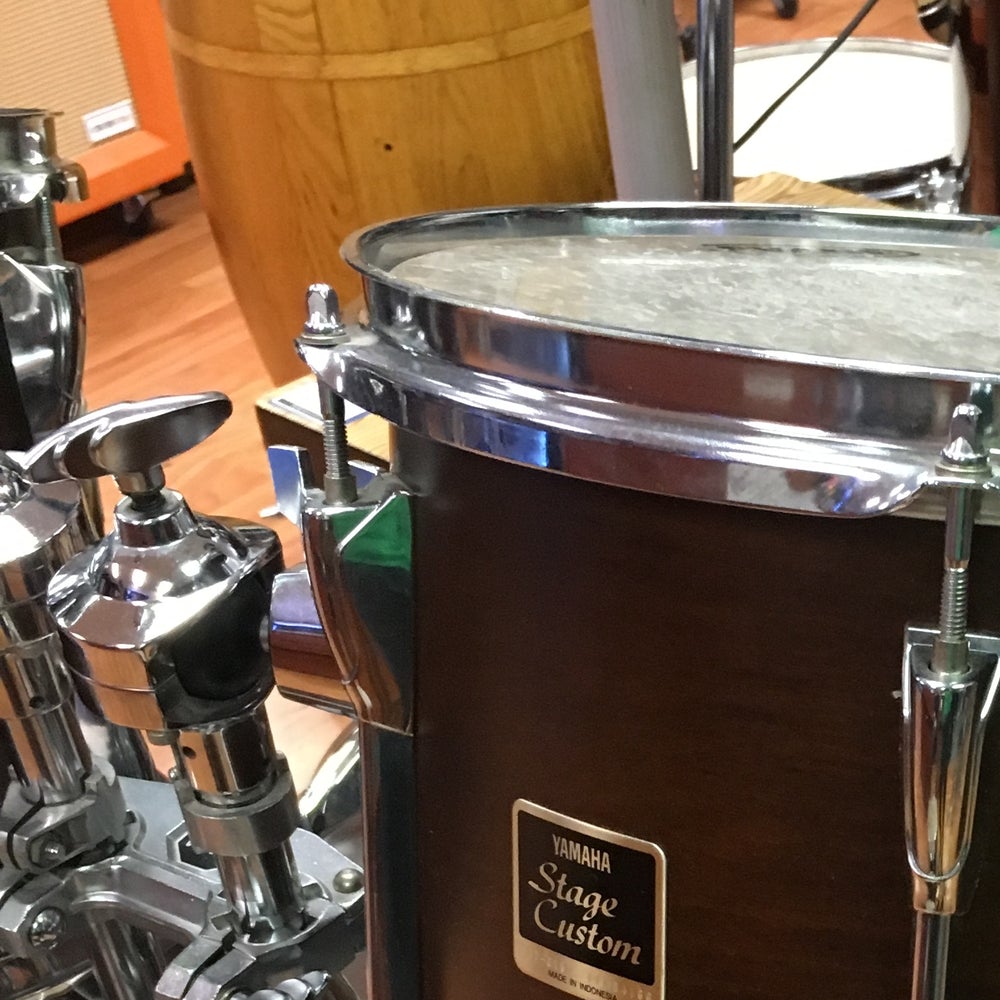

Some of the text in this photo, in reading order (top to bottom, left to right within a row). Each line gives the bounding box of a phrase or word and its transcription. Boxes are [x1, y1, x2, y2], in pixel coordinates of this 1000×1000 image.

[552, 834, 611, 874] YAMAHA
[528, 862, 618, 921] Stage
[534, 899, 642, 965] Custom
[548, 970, 567, 984] MADE
[569, 978, 577, 988] IN
